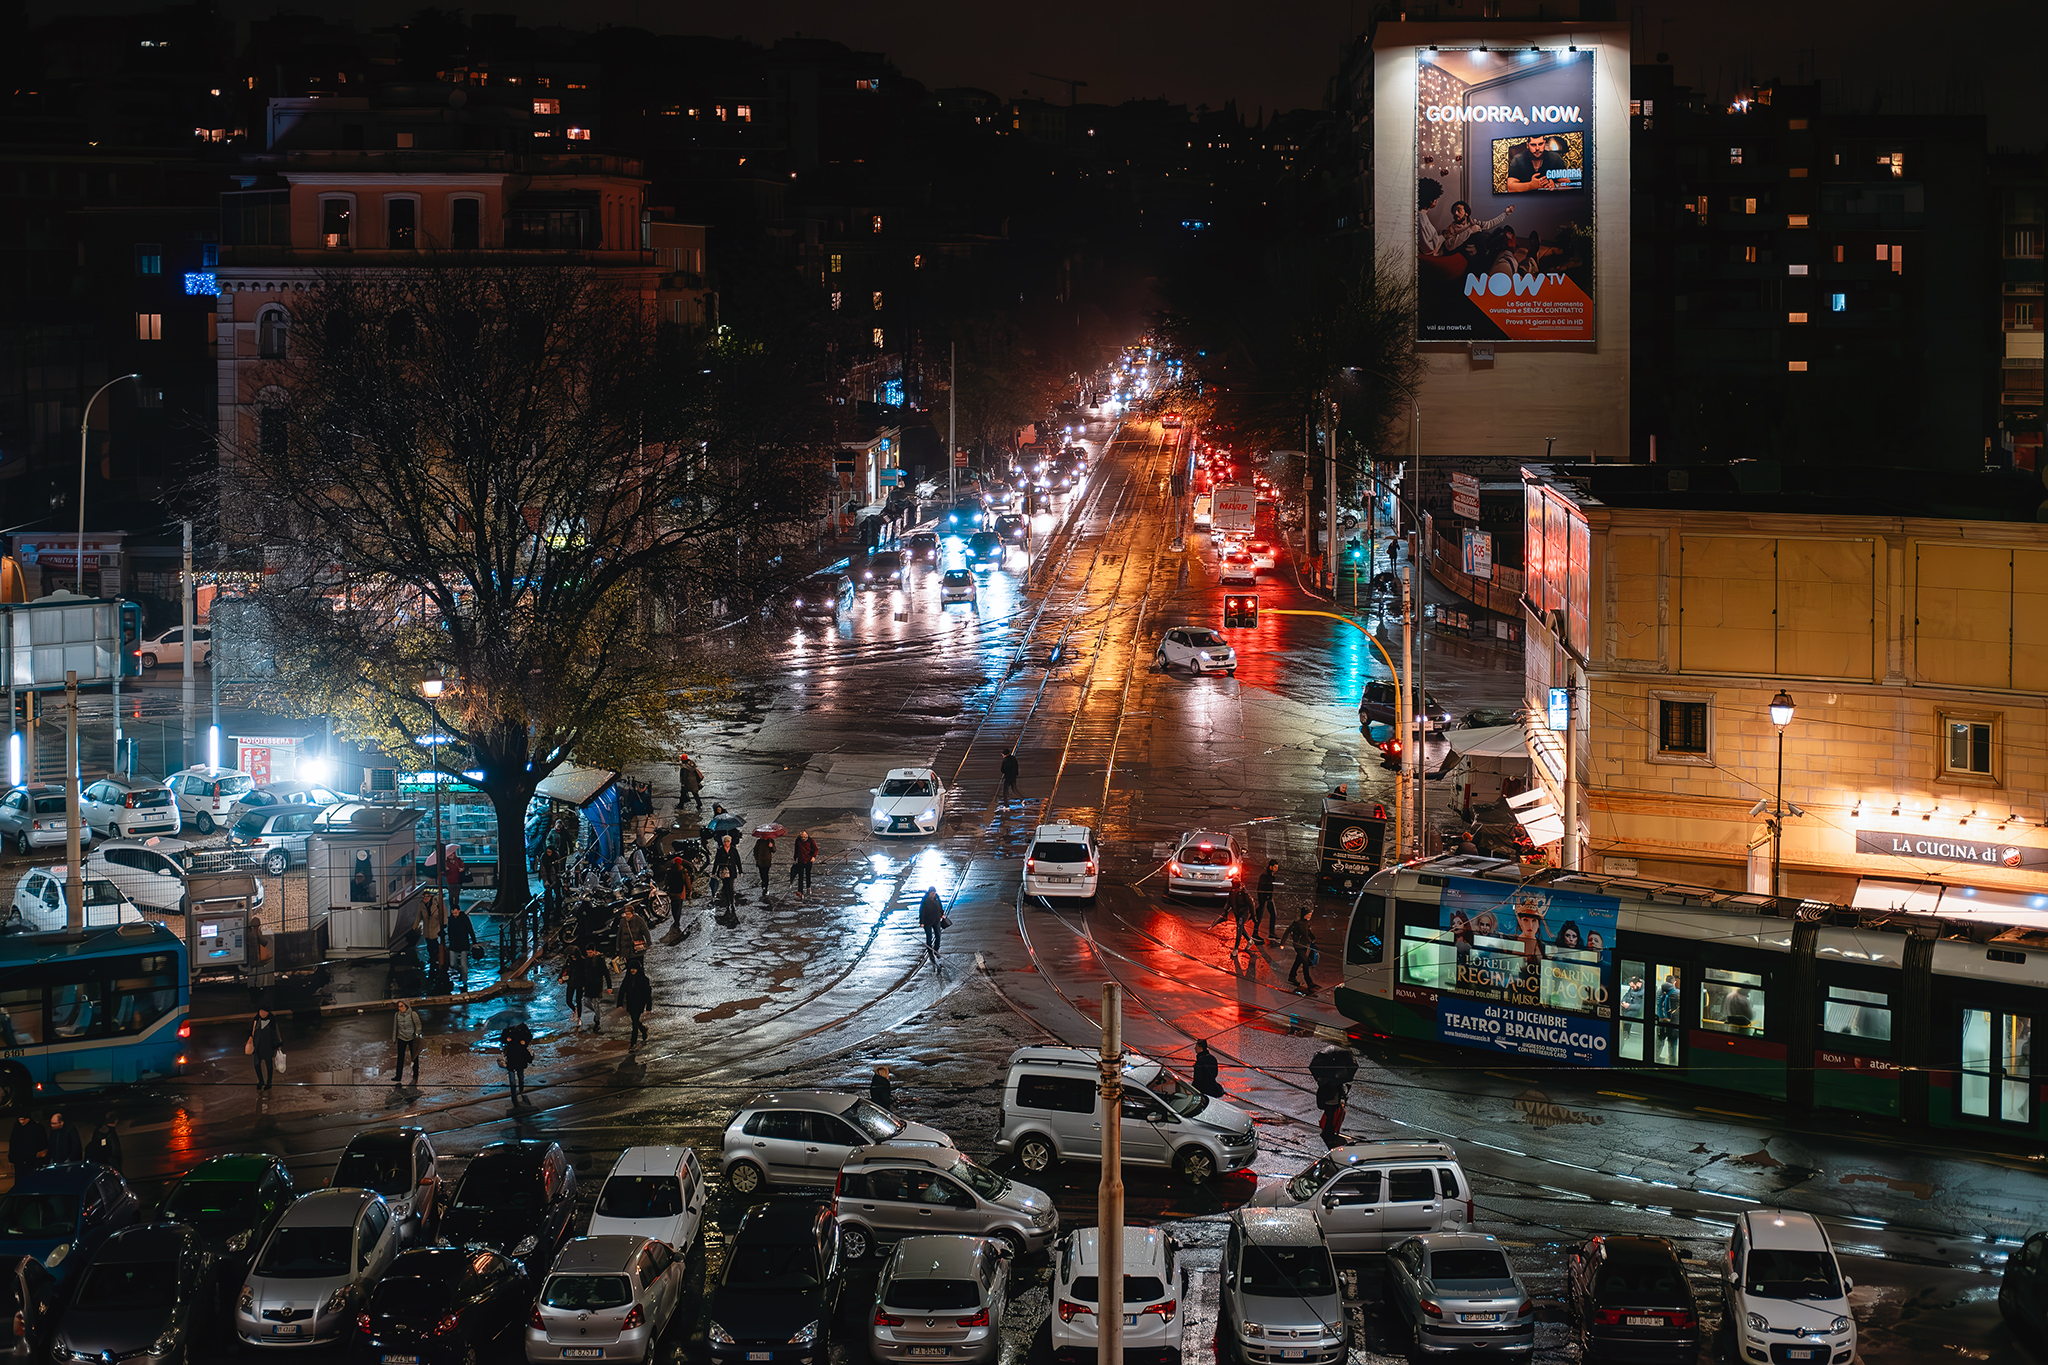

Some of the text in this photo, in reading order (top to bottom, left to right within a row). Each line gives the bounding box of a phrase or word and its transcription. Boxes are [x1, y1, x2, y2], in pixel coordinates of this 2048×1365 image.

[1426, 105, 1584, 126] GOMORRA, NOW.
[1546, 168, 1582, 179] GOMORRA
[1464, 272, 1566, 296] NOW TV
[1220, 502, 1248, 510] MARR
[1893, 838, 1912, 852] LA
[1916, 841, 1978, 860] CUCINA
[1982, 848, 1997, 862] di
[1465, 954, 1594, 983] LORELLA CUCCARINI
[1396, 989, 1416, 998] ROMA
[1457, 964, 1518, 992] REGINA
[1516, 978, 1525, 988] DI
[1526, 976, 1608, 1003] GHIACCIO
[1485, 1006, 1568, 1028] dal 21 DICEMBRE
[1445, 1012, 1607, 1051] TEATRO BRANCACCIO
[1870, 1061, 1891, 1070] atac
